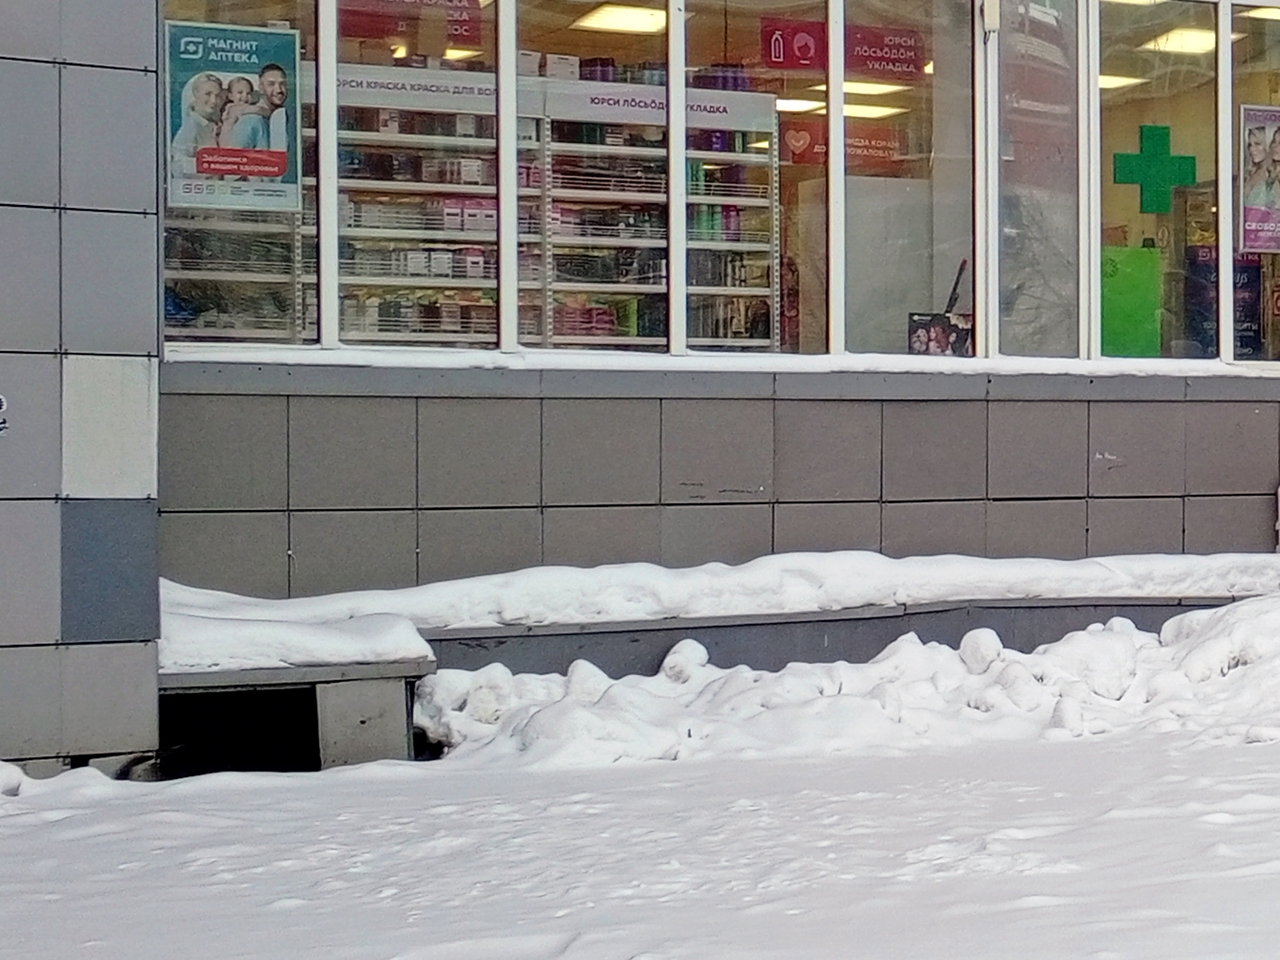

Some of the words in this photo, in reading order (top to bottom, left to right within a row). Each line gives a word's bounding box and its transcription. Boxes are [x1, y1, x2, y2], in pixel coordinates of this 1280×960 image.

[208, 38, 259, 51] МАГНИТ
[208, 51, 259, 64] АПТЕКА
[867, 60, 916, 73] УКЛАДКА
[366, 80, 407, 91] КРАСКА
[409, 82, 450, 94] КРАСКА
[590, 96, 620, 107] ЮРСИ
